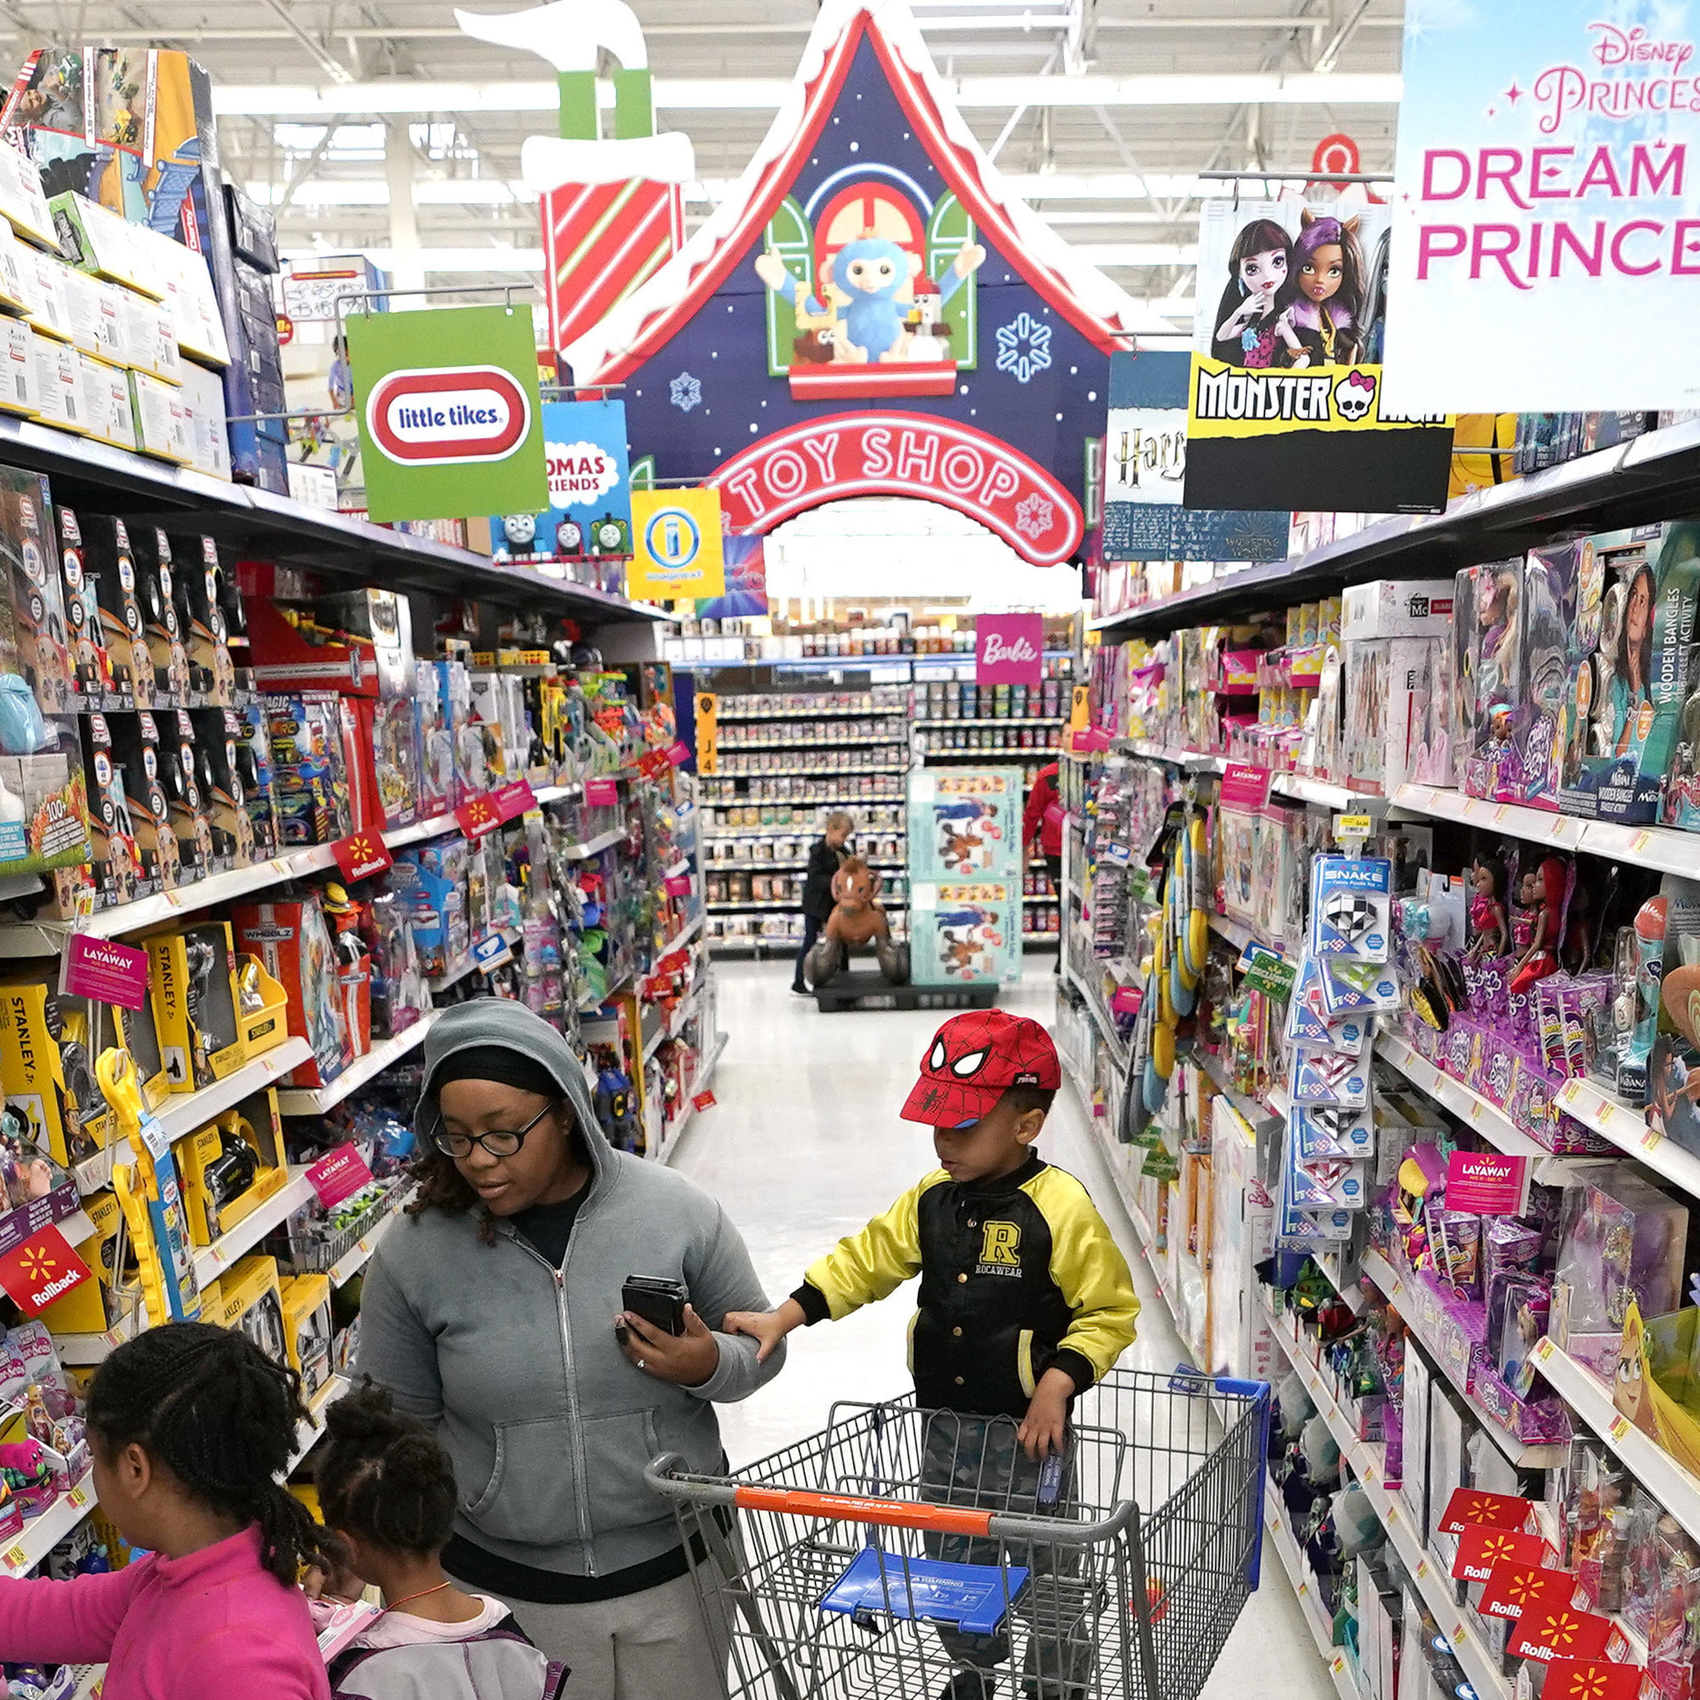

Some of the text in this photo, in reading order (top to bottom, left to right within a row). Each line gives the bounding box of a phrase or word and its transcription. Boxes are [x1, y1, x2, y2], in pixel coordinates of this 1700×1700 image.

[1587, 22, 1694, 69] Disney
[1420, 142, 1689, 210] DREAM
[1197, 373, 1332, 422] MONSTER
[399, 406, 498, 429] little tikes
[548, 455, 605, 477] OMAS
[729, 428, 1020, 518] TOY SHOP
[548, 477, 600, 492] RIENDS
[982, 634, 1039, 664] Barbie
[1658, 587, 1682, 706] WOODEN BANGLES
[1324, 870, 1384, 883] SNAKE
[83, 947, 134, 970] LAYAWAY
[159, 946, 176, 1007] STANLEY
[11, 996, 34, 1071] STANLEY
[316, 1155, 350, 1183] LAYAWAY
[1462, 1163, 1512, 1177] LAYAWAY
[30, 1268, 81, 1306] Rollback
